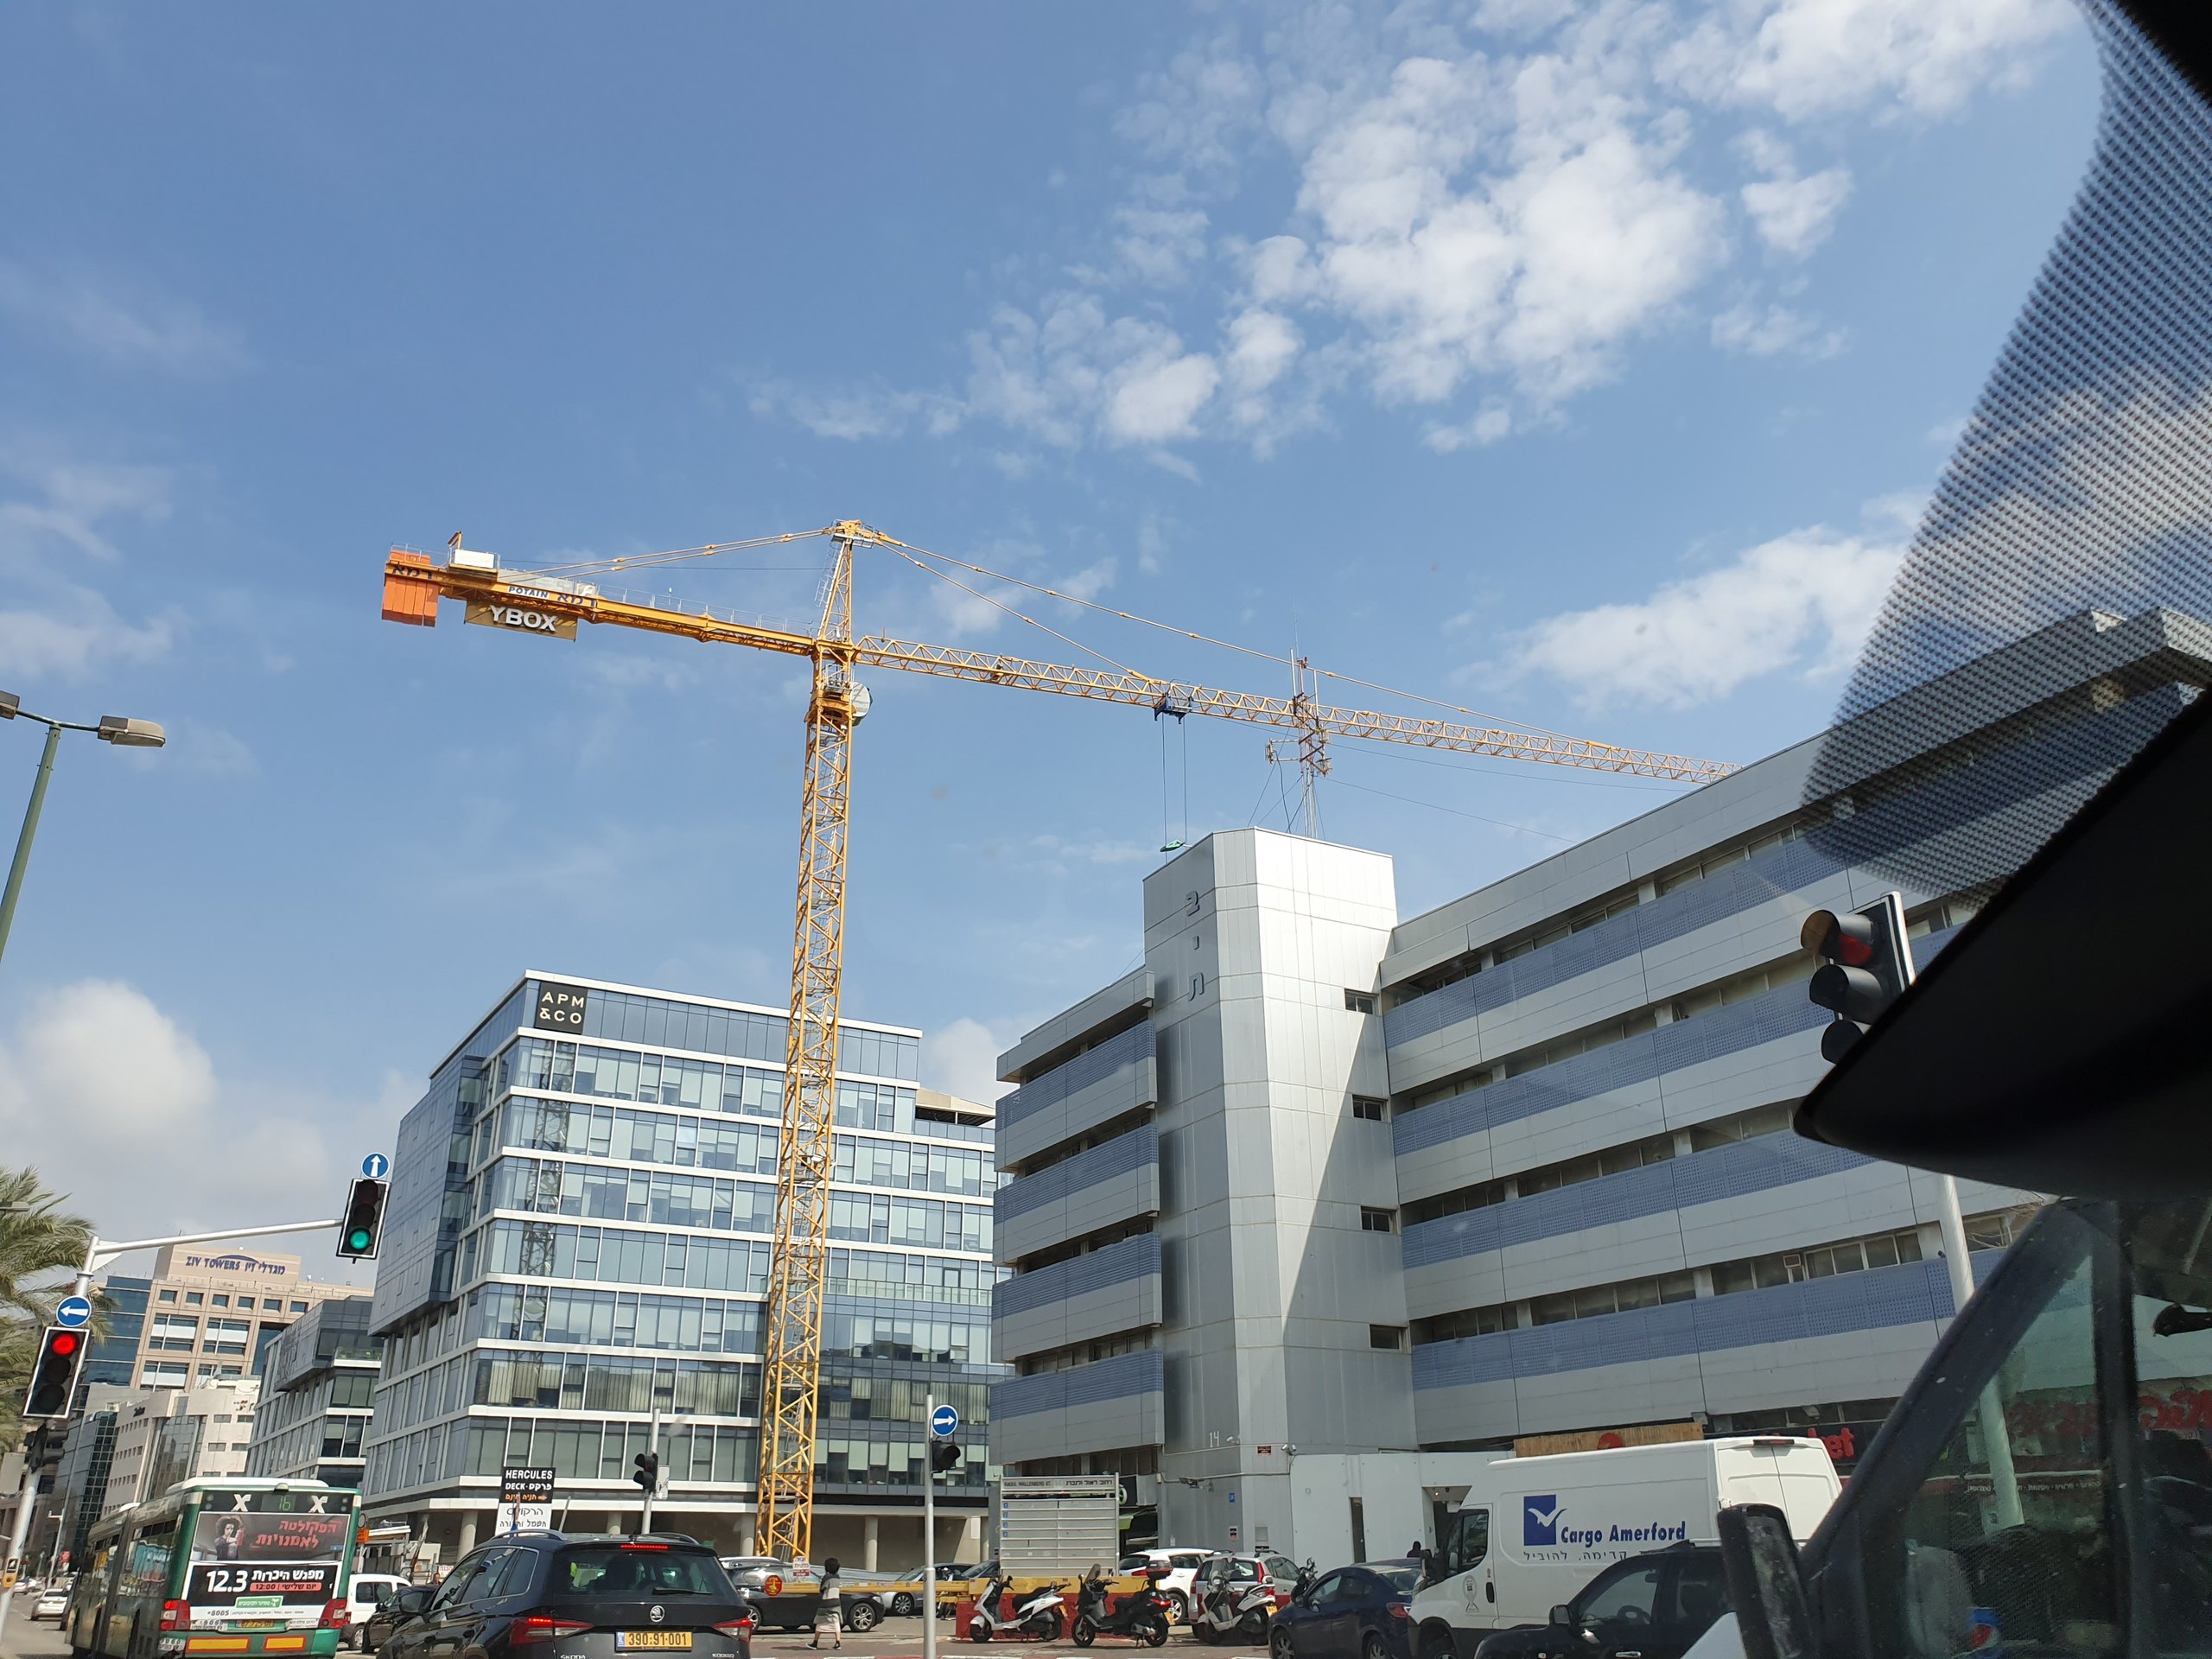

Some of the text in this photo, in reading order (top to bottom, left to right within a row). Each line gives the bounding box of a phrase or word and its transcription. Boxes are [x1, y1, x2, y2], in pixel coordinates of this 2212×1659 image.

[508, 586, 549, 598] POTAIN
[490, 605, 557, 632] YBOX
[541, 991, 585, 1008] APM
[539, 1007, 582, 1024] &CO
[185, 1255, 241, 1271] ZIV TOWERS
[257, 1261, 286, 1275] מגדלי
[505, 1469, 553, 1479] HERCULES
[505, 1482, 525, 1491] DECK
[277, 1495, 291, 1511] 16
[1560, 1521, 1685, 1548] Cargo Amerford
[206, 1570, 249, 1593] 12.3
[251, 1569, 325, 1582] מפגש היכרות
